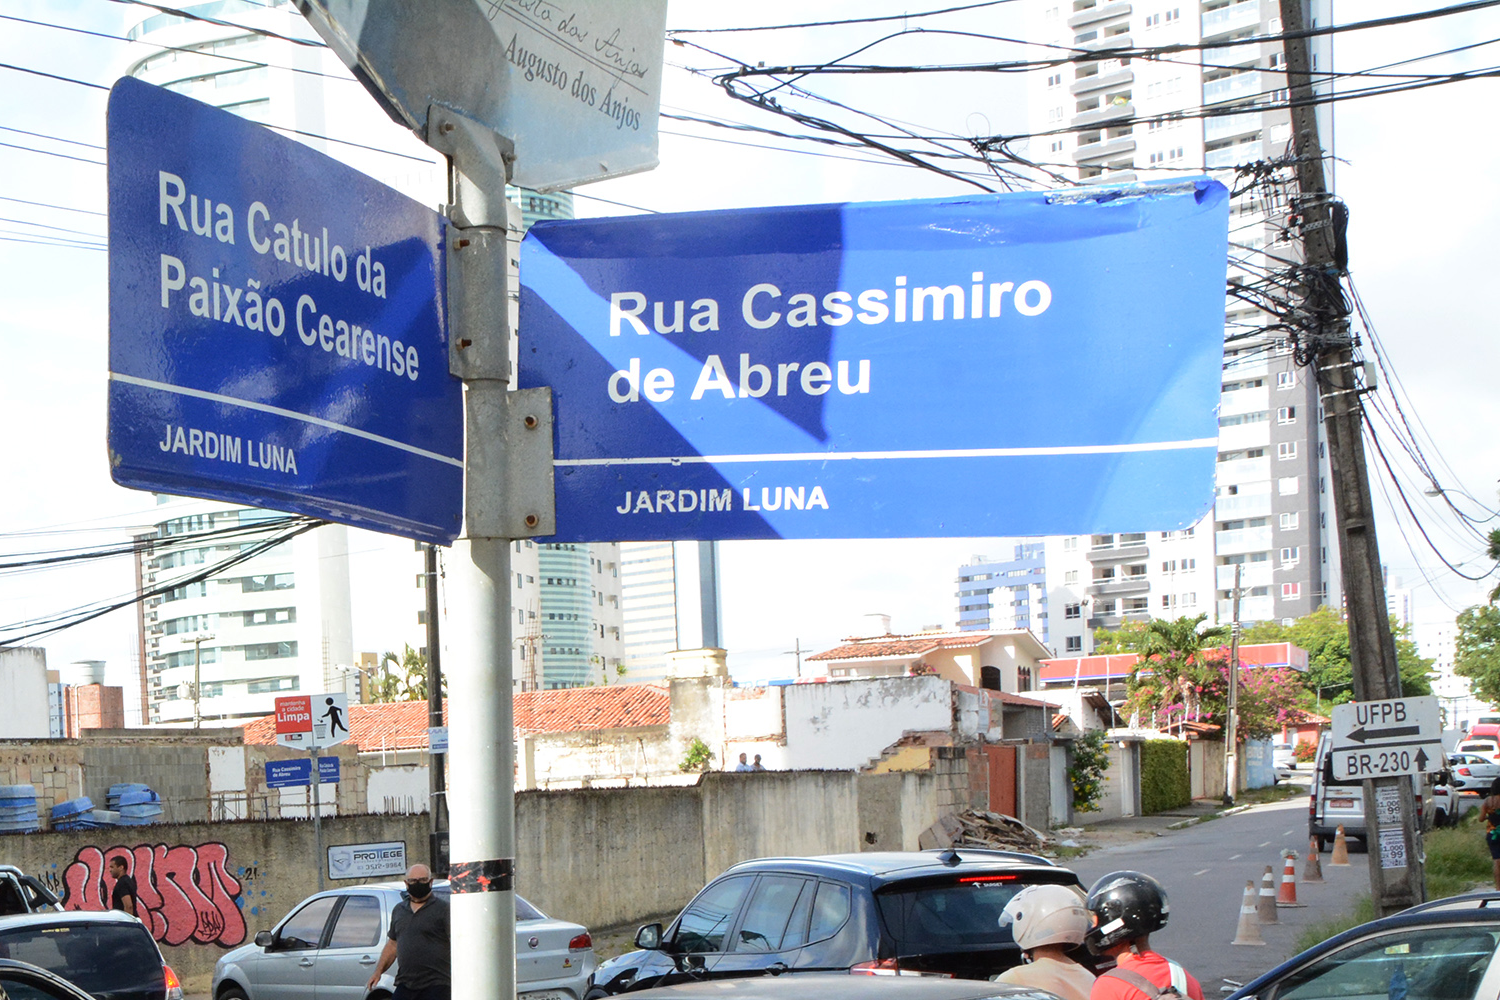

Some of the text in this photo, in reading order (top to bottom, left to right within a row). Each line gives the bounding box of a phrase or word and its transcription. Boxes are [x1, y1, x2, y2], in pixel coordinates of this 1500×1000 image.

[504, 33, 641, 131] Augusto dos Anjos
[158, 171, 387, 299] Rua Catulo da
[160, 254, 419, 381] Paixão Cearense
[608, 271, 1053, 338] Rua Cassimiro
[607, 352, 871, 404] de Abreu
[158, 424, 299, 476] JARDIM LUNA
[616, 486, 829, 515] JARDIM LUNA
[277, 713, 310, 723] Limpa
[1356, 702, 1406, 726] UFPB
[1348, 750, 1410, 776] BR-230
